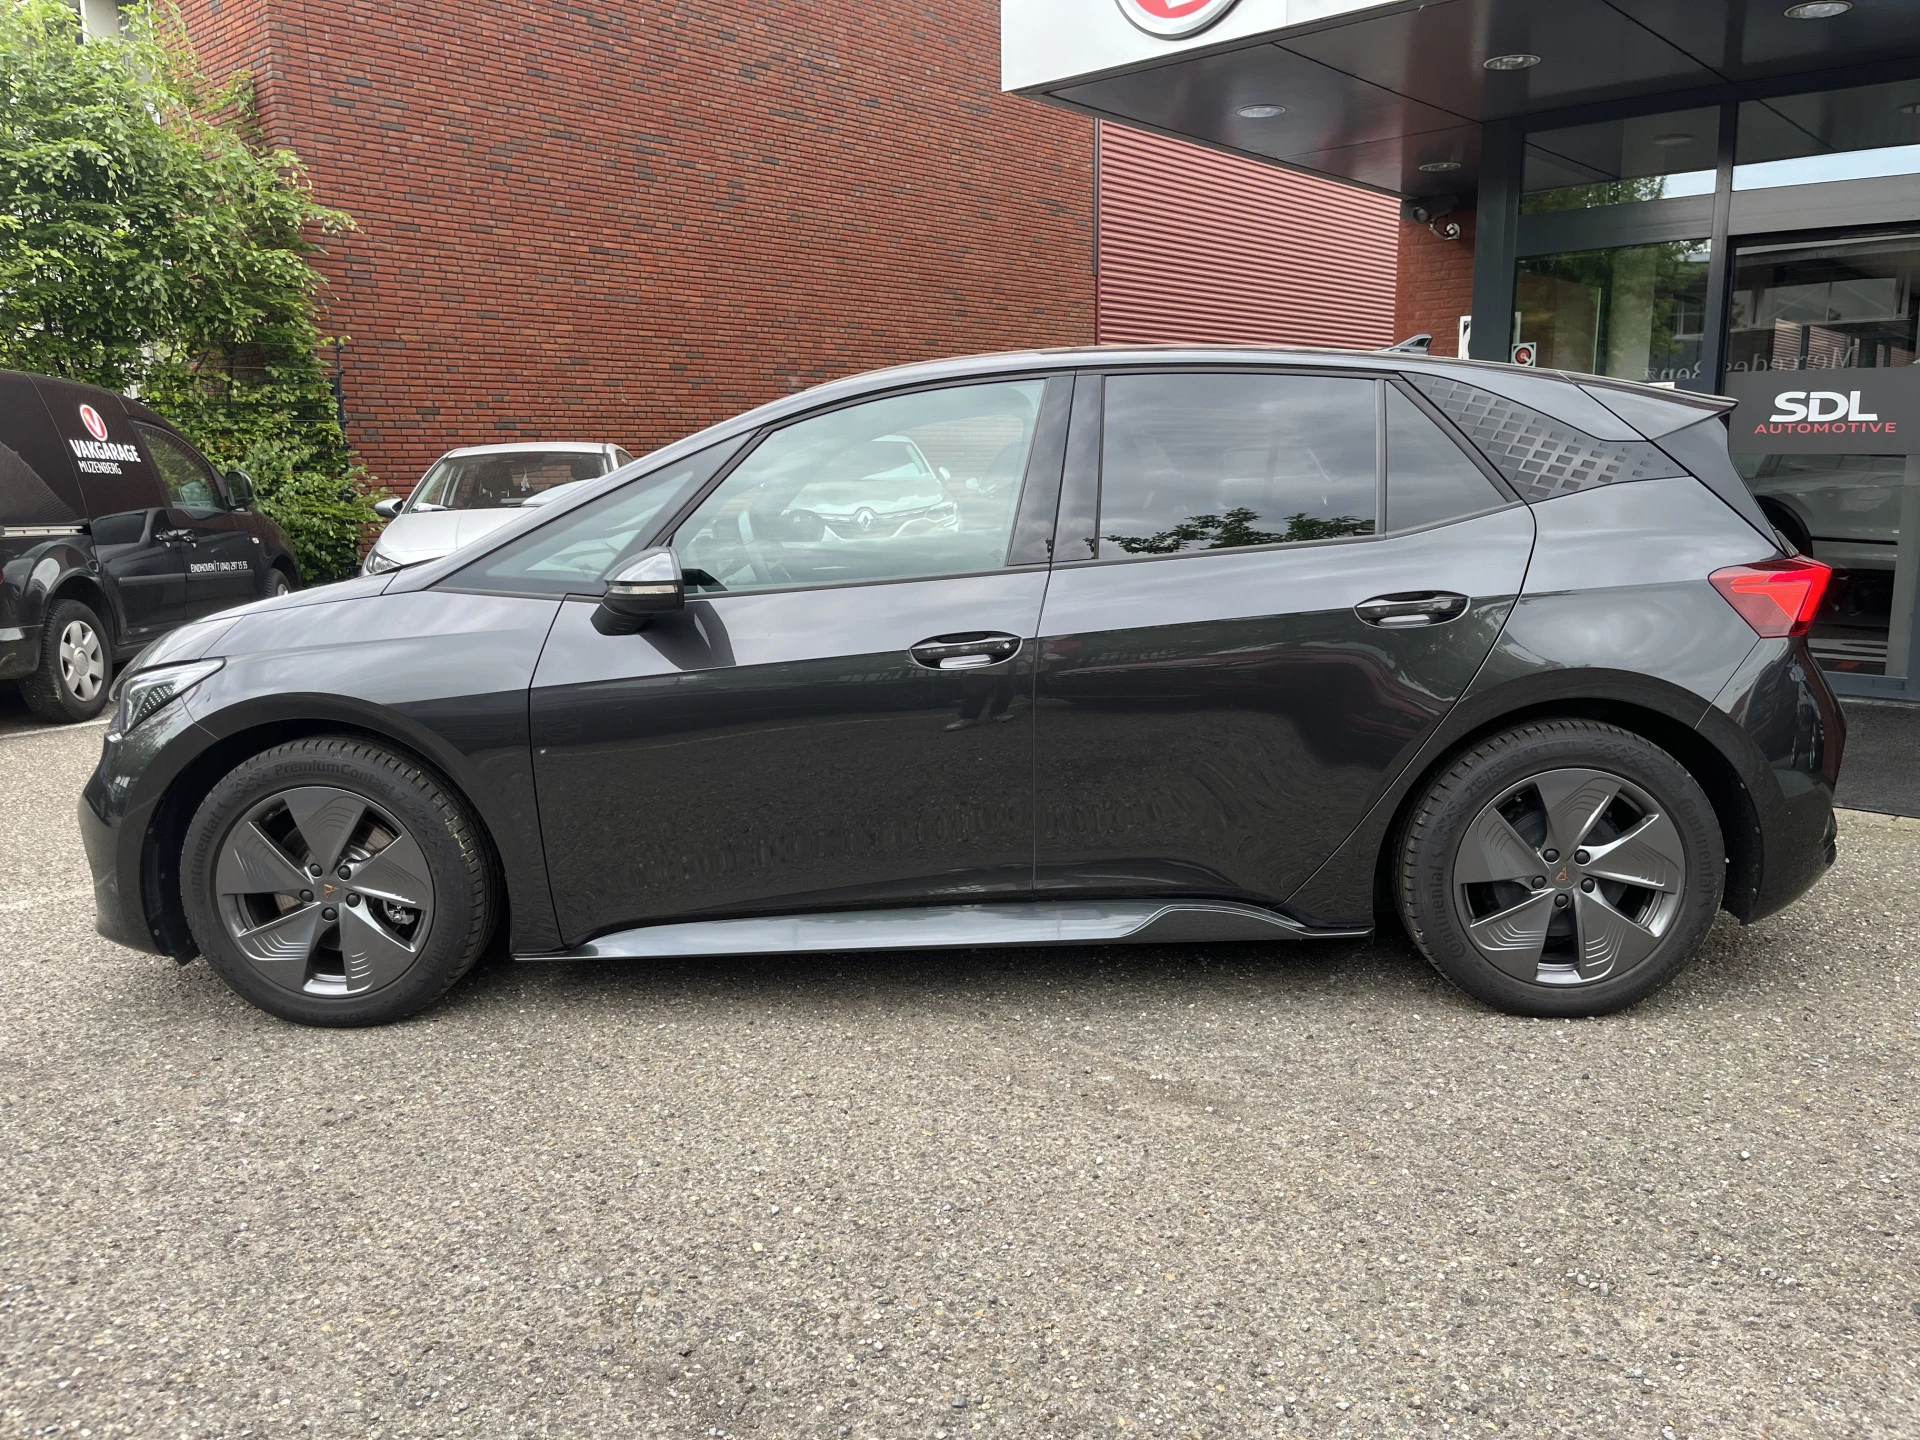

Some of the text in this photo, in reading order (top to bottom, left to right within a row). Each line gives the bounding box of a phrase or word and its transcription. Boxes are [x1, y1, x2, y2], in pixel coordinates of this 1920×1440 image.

[1769, 390, 1878, 422] SDL
[1754, 421, 1897, 435] AUTOMOTIVE
[69, 439, 141, 462] VAKGARAGE
[274, 760, 396, 794] PremiumContact
